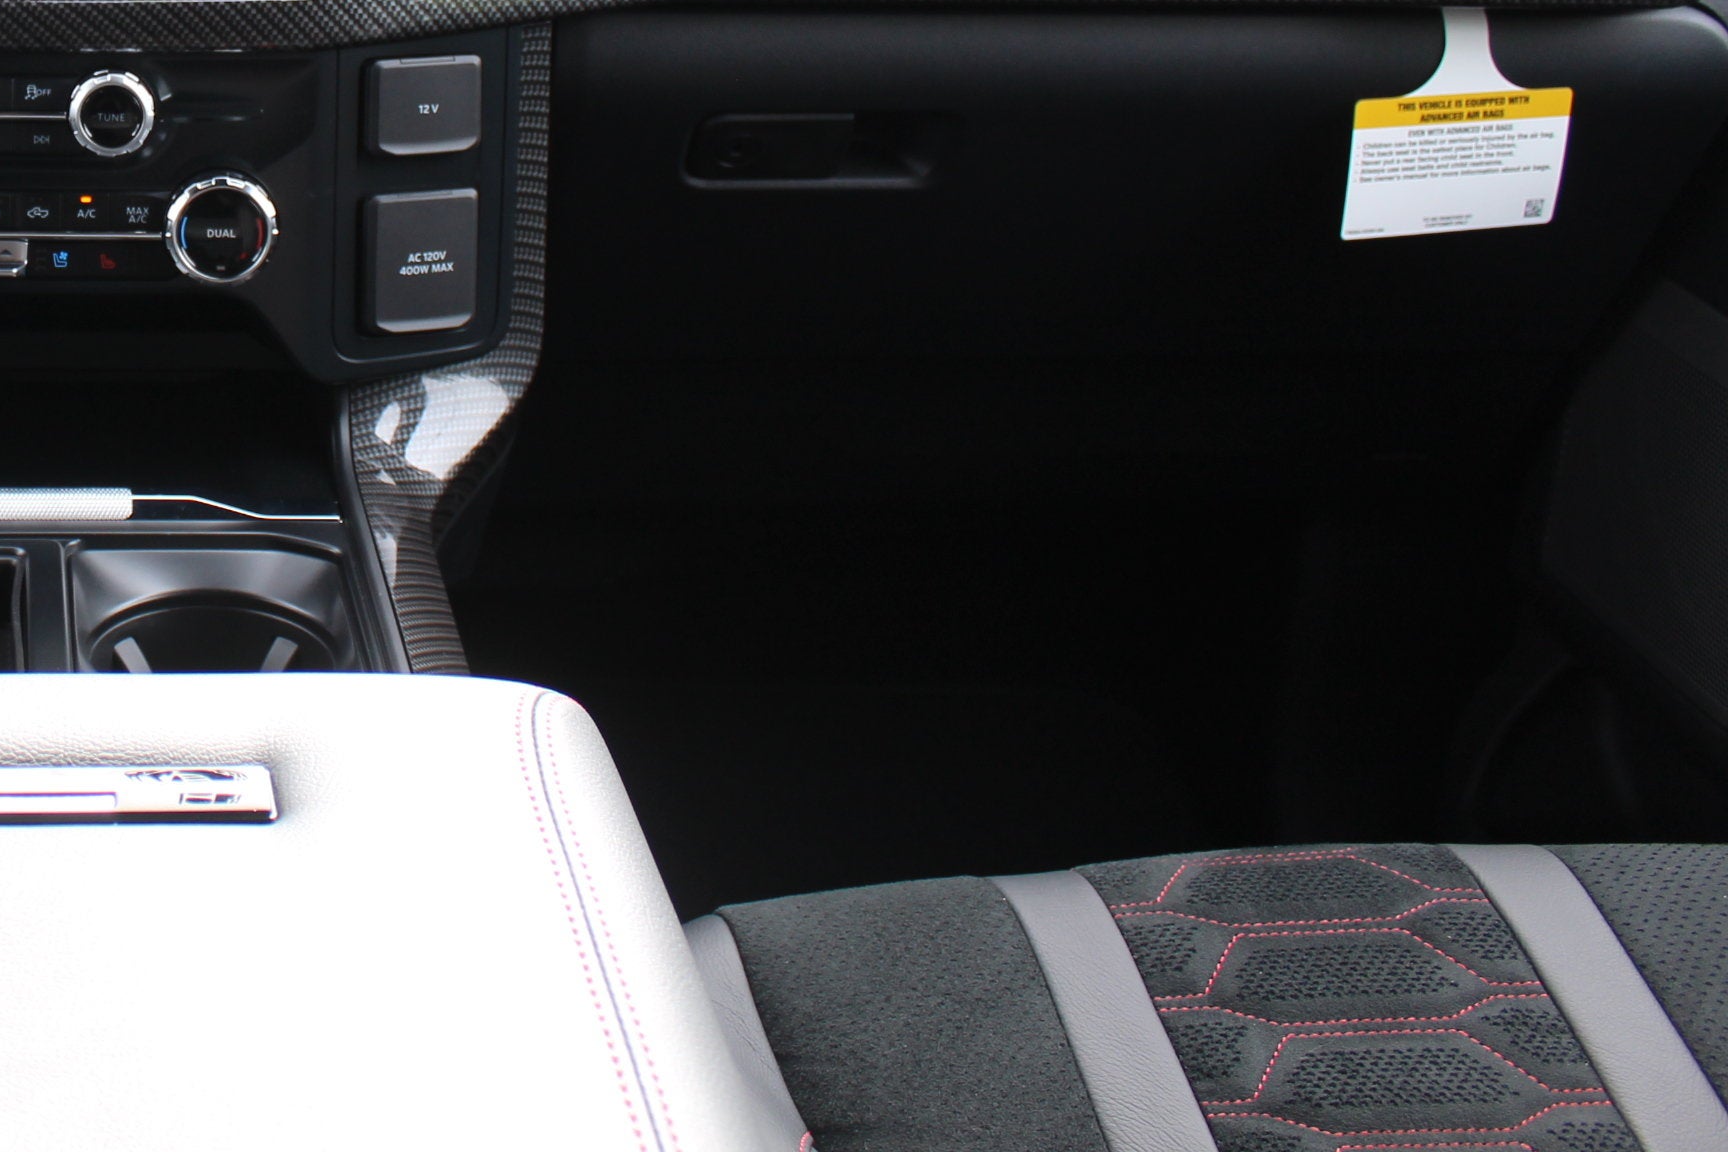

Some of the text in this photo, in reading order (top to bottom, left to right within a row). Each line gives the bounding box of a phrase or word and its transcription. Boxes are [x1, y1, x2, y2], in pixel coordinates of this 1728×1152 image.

[36, 87, 52, 97] OFF
[418, 104, 440, 115] 12 V
[1419, 100, 1452, 110] VEHICLE
[1465, 97, 1505, 108] EQUIPPED
[97, 111, 126, 123] TUNE
[1420, 112, 1464, 123] ADVANCED
[76, 207, 96, 220] A/C
[126, 206, 150, 216] MAX
[128, 214, 147, 225] A/C
[206, 227, 237, 239] DUAL
[407, 250, 446, 264] AC 120V
[398, 263, 455, 277] 400W MAX
